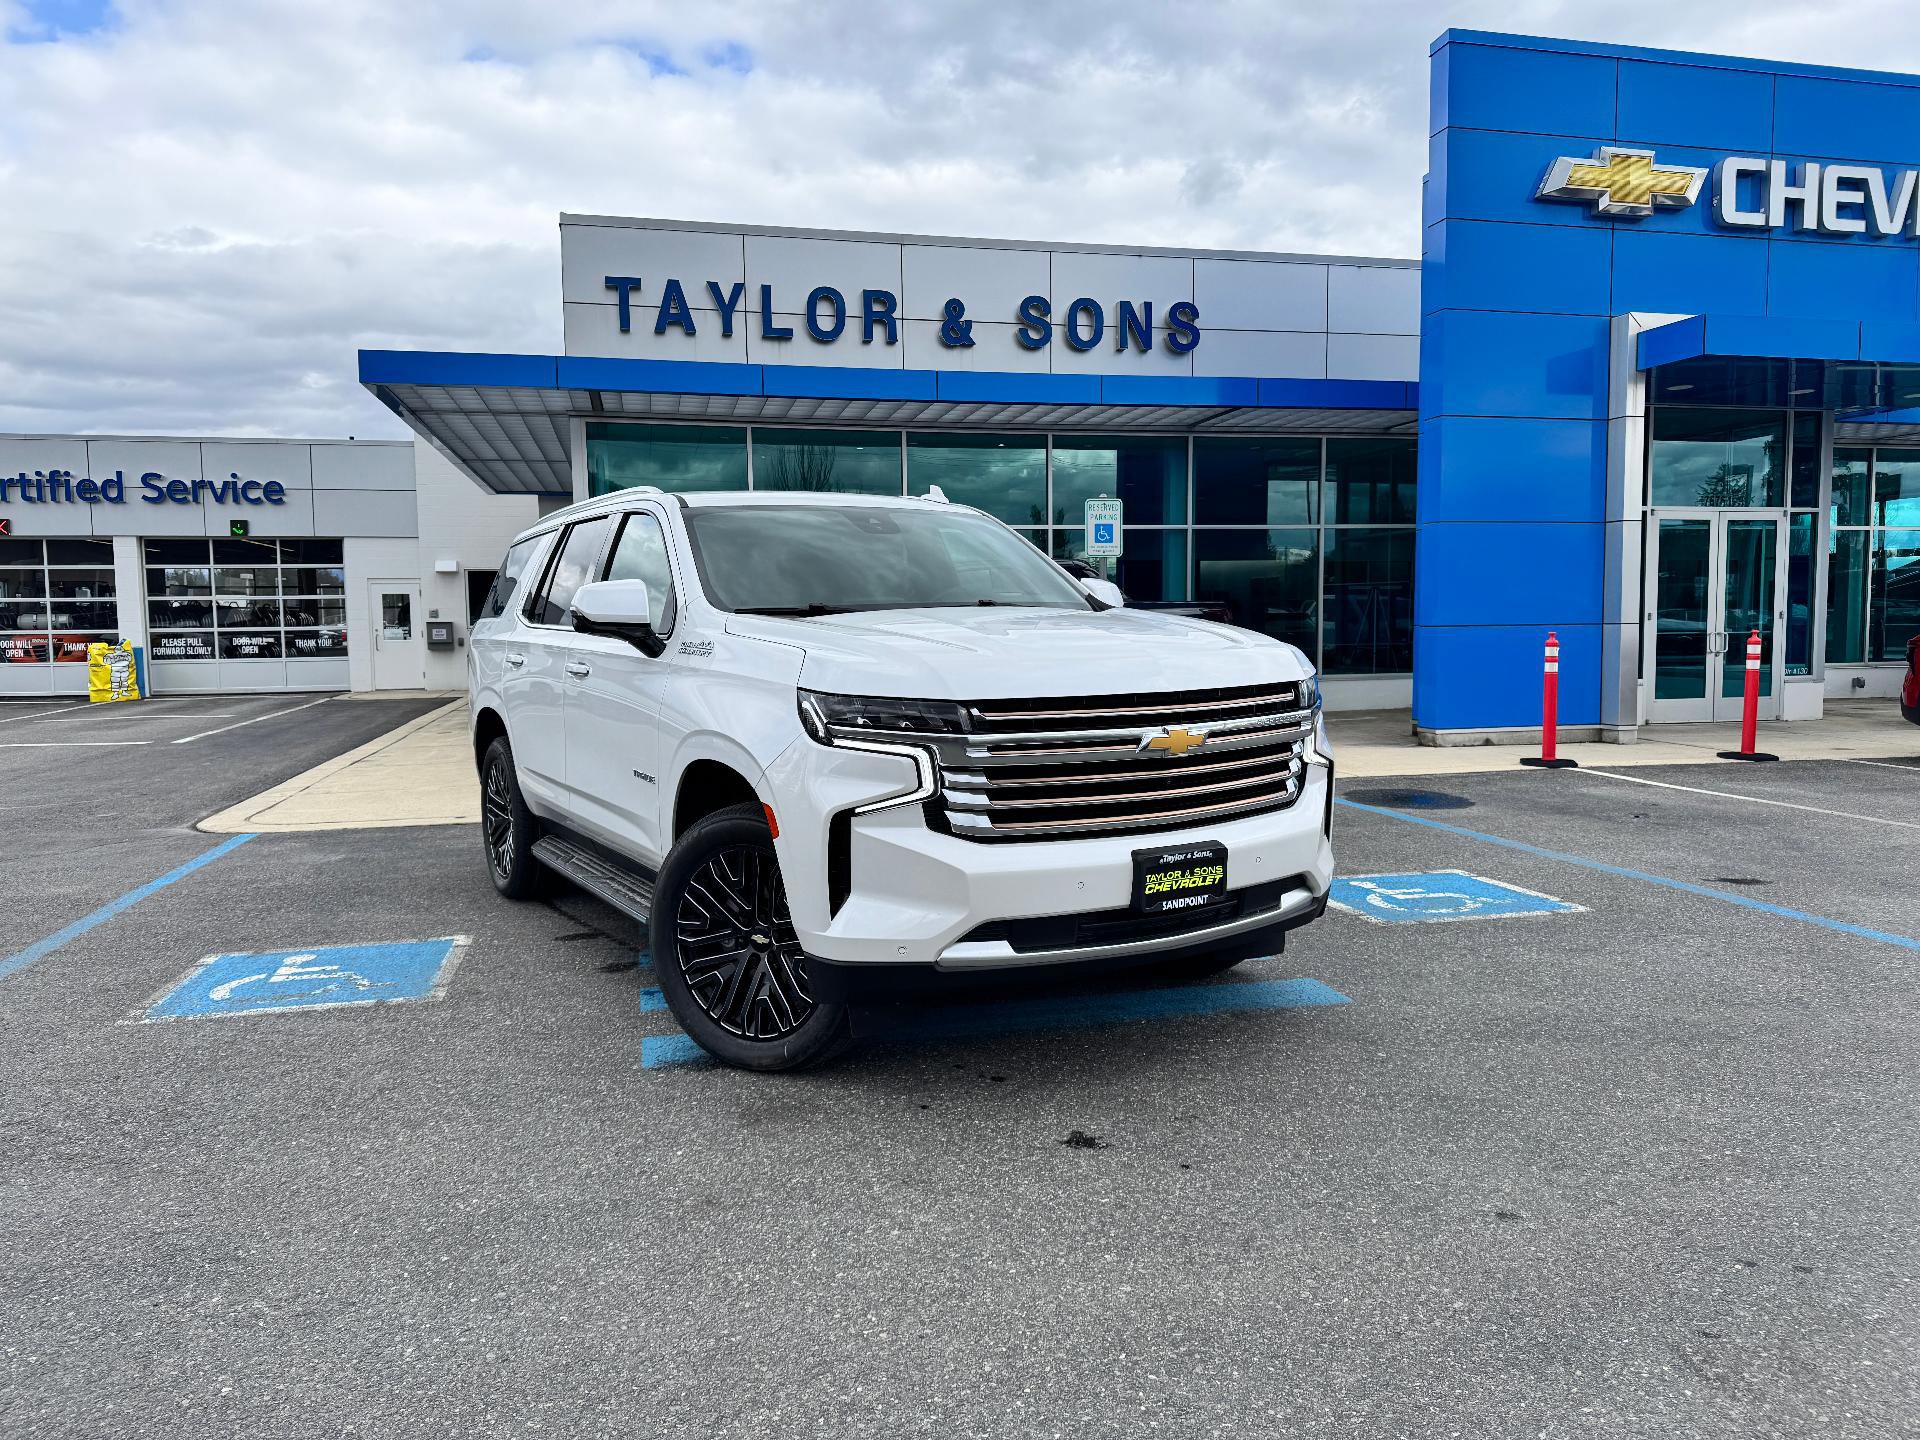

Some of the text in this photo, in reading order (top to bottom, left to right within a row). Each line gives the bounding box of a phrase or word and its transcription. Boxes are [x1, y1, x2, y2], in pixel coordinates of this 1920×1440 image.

[1713, 156, 1920, 238] CHEV
[604, 275, 1201, 352] TAYLOR & SONS
[140, 472, 286, 504] Service
[1088, 503, 1119, 511] RESERVED
[1090, 513, 1118, 521] PARKING
[15, 640, 33, 649] WILL
[63, 642, 86, 652] THANK
[161, 637, 204, 647] PLEASE PULL
[295, 638, 332, 648] THANK YOU!
[5, 648, 24, 658] OPEN
[152, 646, 212, 656] FORWARD SLOWLY
[241, 645, 259, 654] OPEN
[1162, 853, 1186, 863] Taylor
[1192, 850, 1210, 859] Sons
[1145, 865, 1223, 883] TAYLOR & SONS
[1144, 874, 1223, 895] CHEVROLET
[1162, 894, 1209, 911] SANDPOINT
